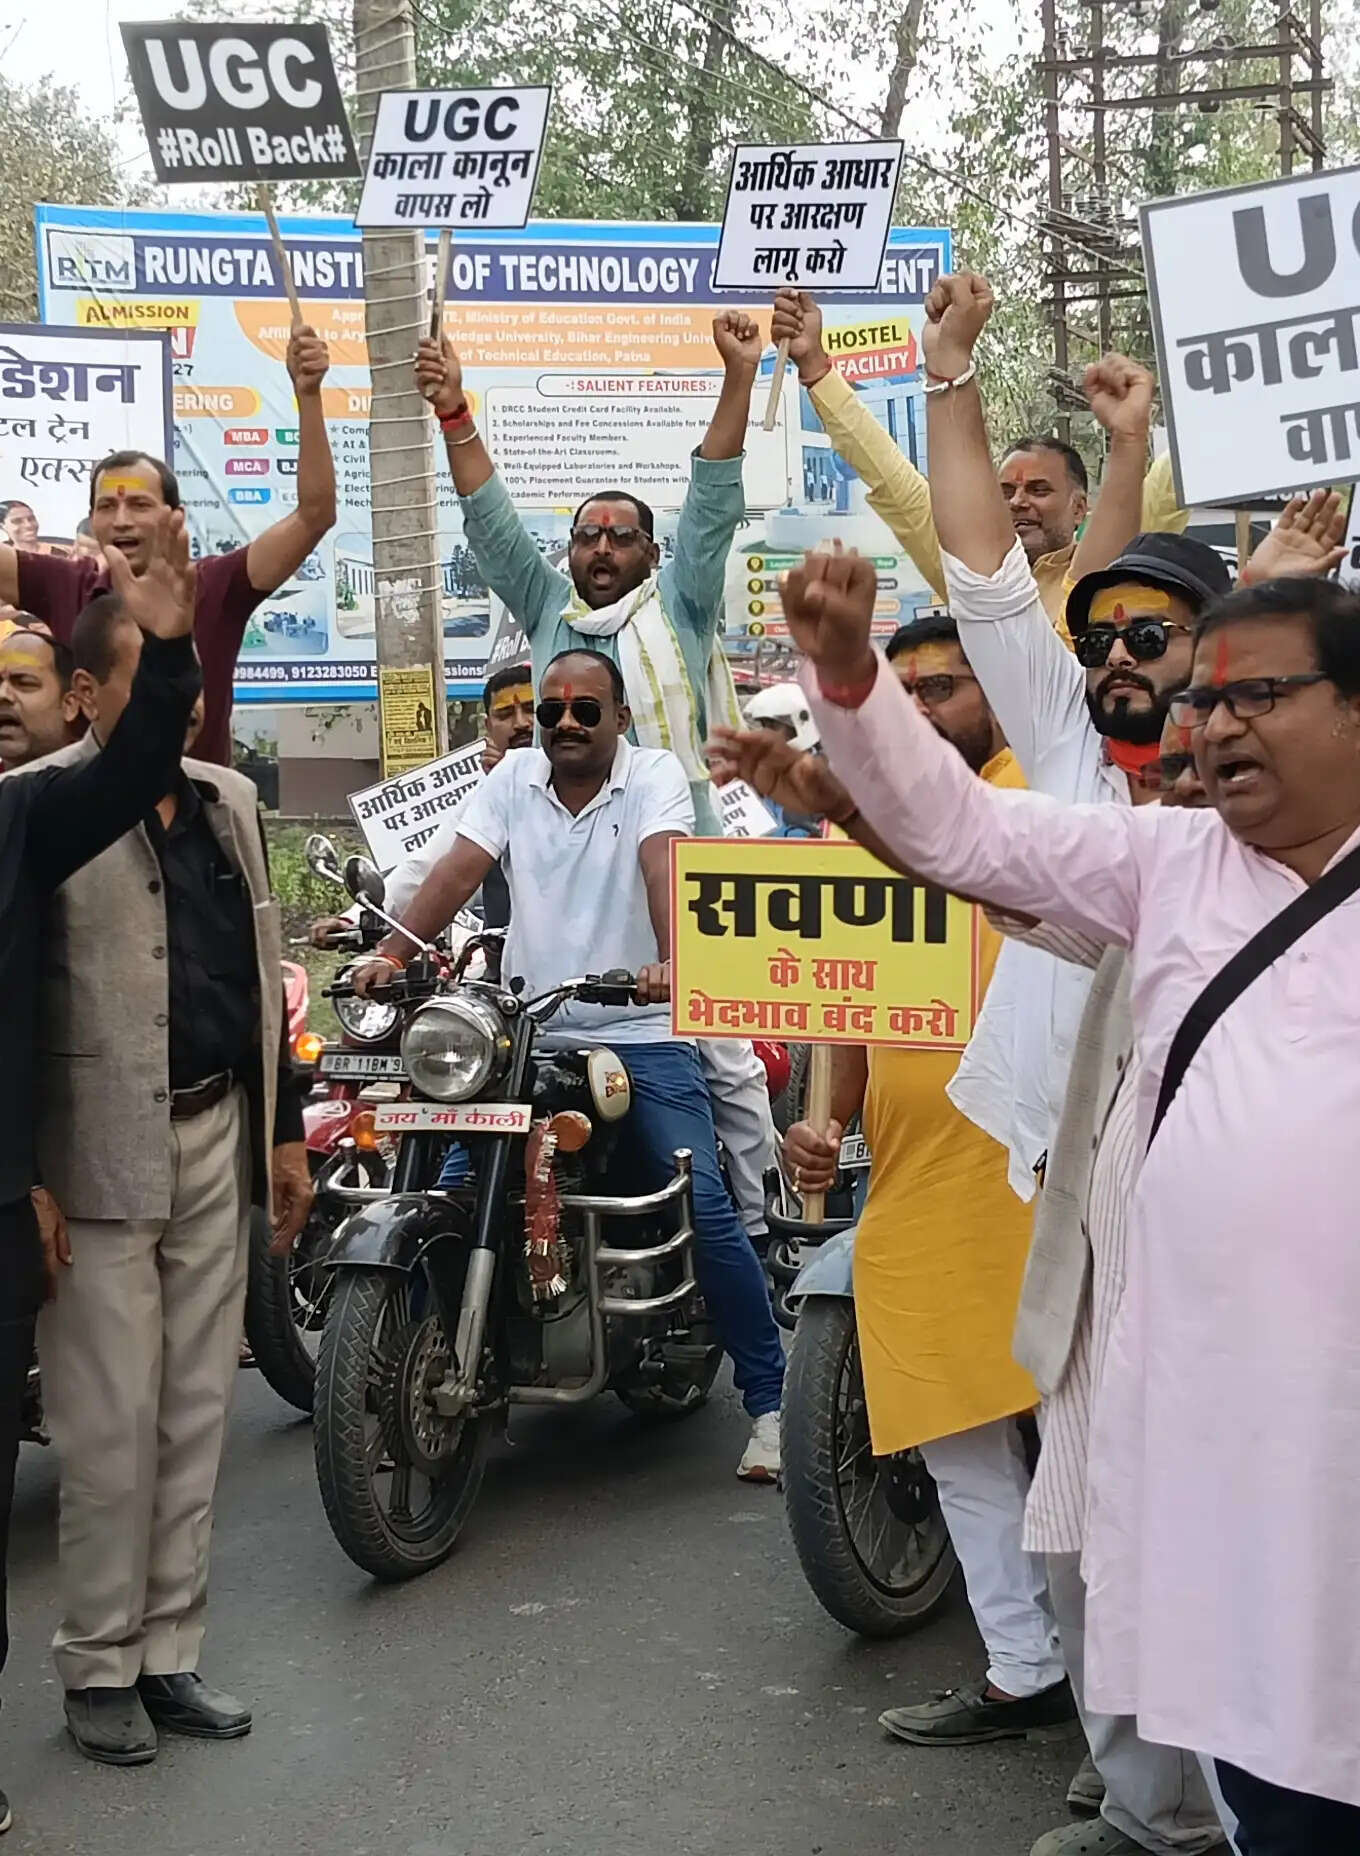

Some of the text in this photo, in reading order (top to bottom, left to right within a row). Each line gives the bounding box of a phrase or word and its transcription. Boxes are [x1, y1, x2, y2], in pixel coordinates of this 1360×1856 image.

[144, 38, 322, 110] UGC
[404, 96, 520, 142] UGC
[157, 124, 347, 168] #Roll Back#
[373, 150, 535, 187] काला कानून
[735, 150, 895, 191] आर्थिक आधार
[394, 186, 493, 218] वापस लो
[750, 202, 868, 230] पर आरक्षण
[144, 246, 274, 287] RUNGTA
[452, 254, 491, 290] OF
[499, 255, 699, 293] TECHNOLOGY
[752, 247, 801, 281] लागू
[805, 239, 848, 274] करो
[522, 311, 535, 323] of
[540, 311, 603, 324] Education
[643, 313, 656, 324] of
[660, 313, 692, 325] India
[605, 331, 680, 347] Engineering
[827, 325, 902, 350] HOSTEL
[478, 349, 540, 361] Technical
[837, 351, 910, 377] FACILITY
[527, 405, 560, 413] Student
[589, 405, 609, 413] Card
[48, 414, 90, 443] ट्रेन
[558, 420, 573, 428] and
[575, 420, 590, 428] Fee
[233, 461, 261, 472] MCA
[510, 490, 545, 498] cademic
[291, 665, 367, 680] 9123283050
[358, 778, 427, 820] आर्थिक
[382, 811, 409, 832] पर
[768, 947, 879, 991] के साथ
[688, 989, 960, 1038] भेदभाव बंद करो
[333, 1057, 350, 1071] BR
[379, 1107, 526, 1127] जय माँ काली
